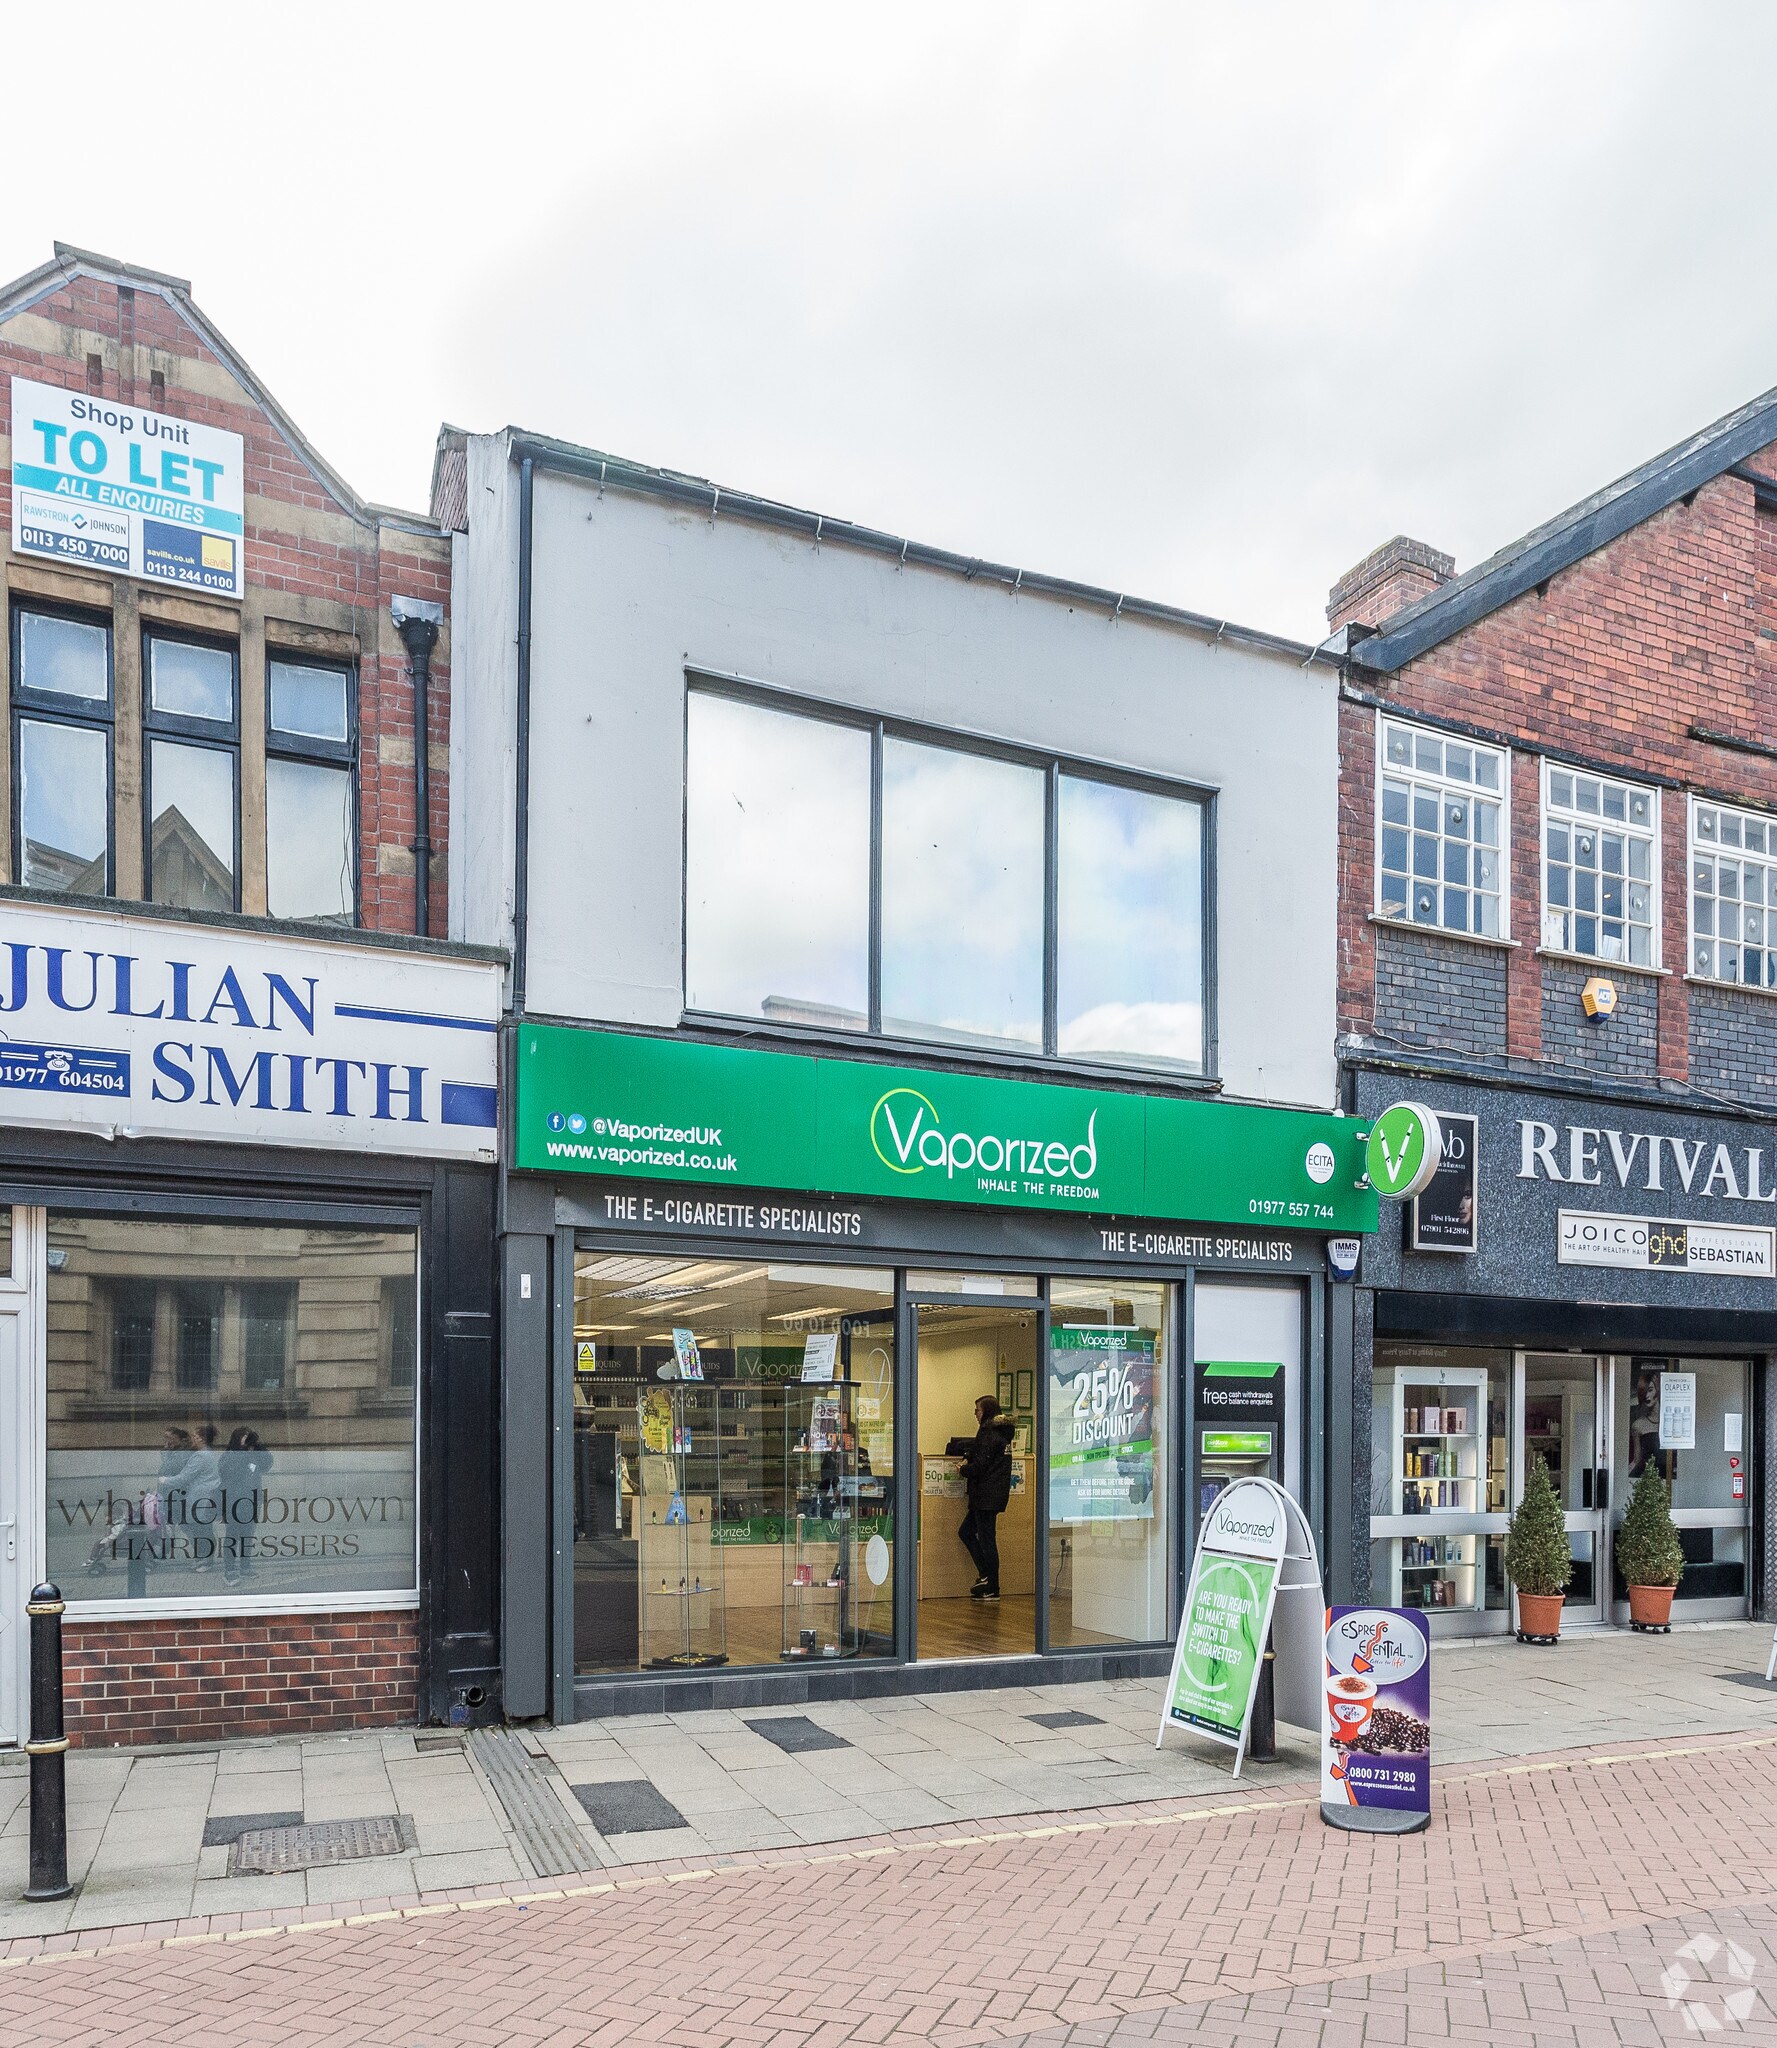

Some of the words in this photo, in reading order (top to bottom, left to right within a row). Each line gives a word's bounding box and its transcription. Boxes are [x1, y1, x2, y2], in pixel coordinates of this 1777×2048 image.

[71, 398, 134, 434] Shop
[143, 418, 189, 445] Unit
[33, 419, 108, 475] TO
[129, 442, 224, 502] LET
[55, 477, 92, 499] ALL
[98, 486, 204, 524] ENQUIRIES
[24, 505, 69, 523] RAWSTRON
[90, 519, 127, 535] JOHNSON
[22, 529, 54, 547] 0113
[59, 537, 87, 554] 450
[91, 542, 128, 563] 7000
[147, 549, 195, 565] savills.co.uk
[147, 561, 176, 577] 0113
[179, 568, 201, 582] 244
[204, 573, 233, 589] 0100
[203, 557, 231, 570] savills
[0, 941, 319, 1036] JULIAN
[0, 1065, 48, 1084] 1977
[59, 1071, 125, 1090] 604504
[151, 1041, 429, 1123] SMITH
[592, 1117, 723, 1147] @VaporizedUK
[884, 1102, 1099, 1180] Vaporized
[546, 1142, 738, 1172] www.vaporized.co.uk
[1308, 1154, 1333, 1168] ECITA
[1515, 1119, 1777, 1203] REVIVAL
[977, 1178, 1017, 1192] INHALE
[1023, 1182, 1044, 1194] THE
[1050, 1184, 1100, 1199] FREEDOM
[604, 1195, 637, 1221] THE
[643, 1198, 754, 1229] E-CIGARETTE
[760, 1206, 861, 1236] SPECIALISTS
[1249, 1199, 1284, 1215] 01977
[1288, 1202, 1310, 1217] 557
[1314, 1204, 1334, 1218] 744
[1100, 1230, 1125, 1252] THE
[1129, 1233, 1212, 1257] E-CIGARETTE
[1216, 1238, 1292, 1261] SPECIALISTS
[1335, 1242, 1357, 1251] IMMS
[1564, 1224, 1647, 1245] JOICO
[1649, 1227, 1687, 1264] ghd
[1688, 1236, 1765, 1248] PROFESSIONAL
[1564, 1242, 1576, 1250] THE
[1603, 1246, 1630, 1255] HEALTHY
[1632, 1248, 1647, 1256] HAIR
[1689, 1246, 1764, 1264] SEBASTIAN
[1080, 1331, 1127, 1347] Vaporized
[744, 1356, 802, 1376] Vaporiz
[1073, 1367, 1134, 1418] 25%
[1203, 1388, 1228, 1405] free
[1664, 1383, 1691, 1391] OLAPLEX
[1073, 1413, 1133, 1444] DISCOUNT
[925, 1470, 943, 1482] 50p
[56, 1488, 405, 1528] whitfieldbrown
[1219, 1513, 1277, 1538] Vaporized
[111, 1533, 359, 1561] HAIRDRESSERS
[1198, 1590, 1212, 1605] ARE
[1212, 1593, 1228, 1608] YOU
[1228, 1595, 1253, 1615] READY
[1195, 1605, 1205, 1621] TO
[1205, 1608, 1225, 1626] MAKE
[1226, 1613, 1241, 1630] THE
[1192, 1622, 1219, 1641] SWITCH
[1219, 1629, 1229, 1644] TO
[1188, 1638, 1243, 1666] E-CIGARETTES?
[1350, 1767, 1372, 1779] 0800
[1374, 1769, 1390, 1780] 731
[1393, 1771, 1416, 1783] 2980
